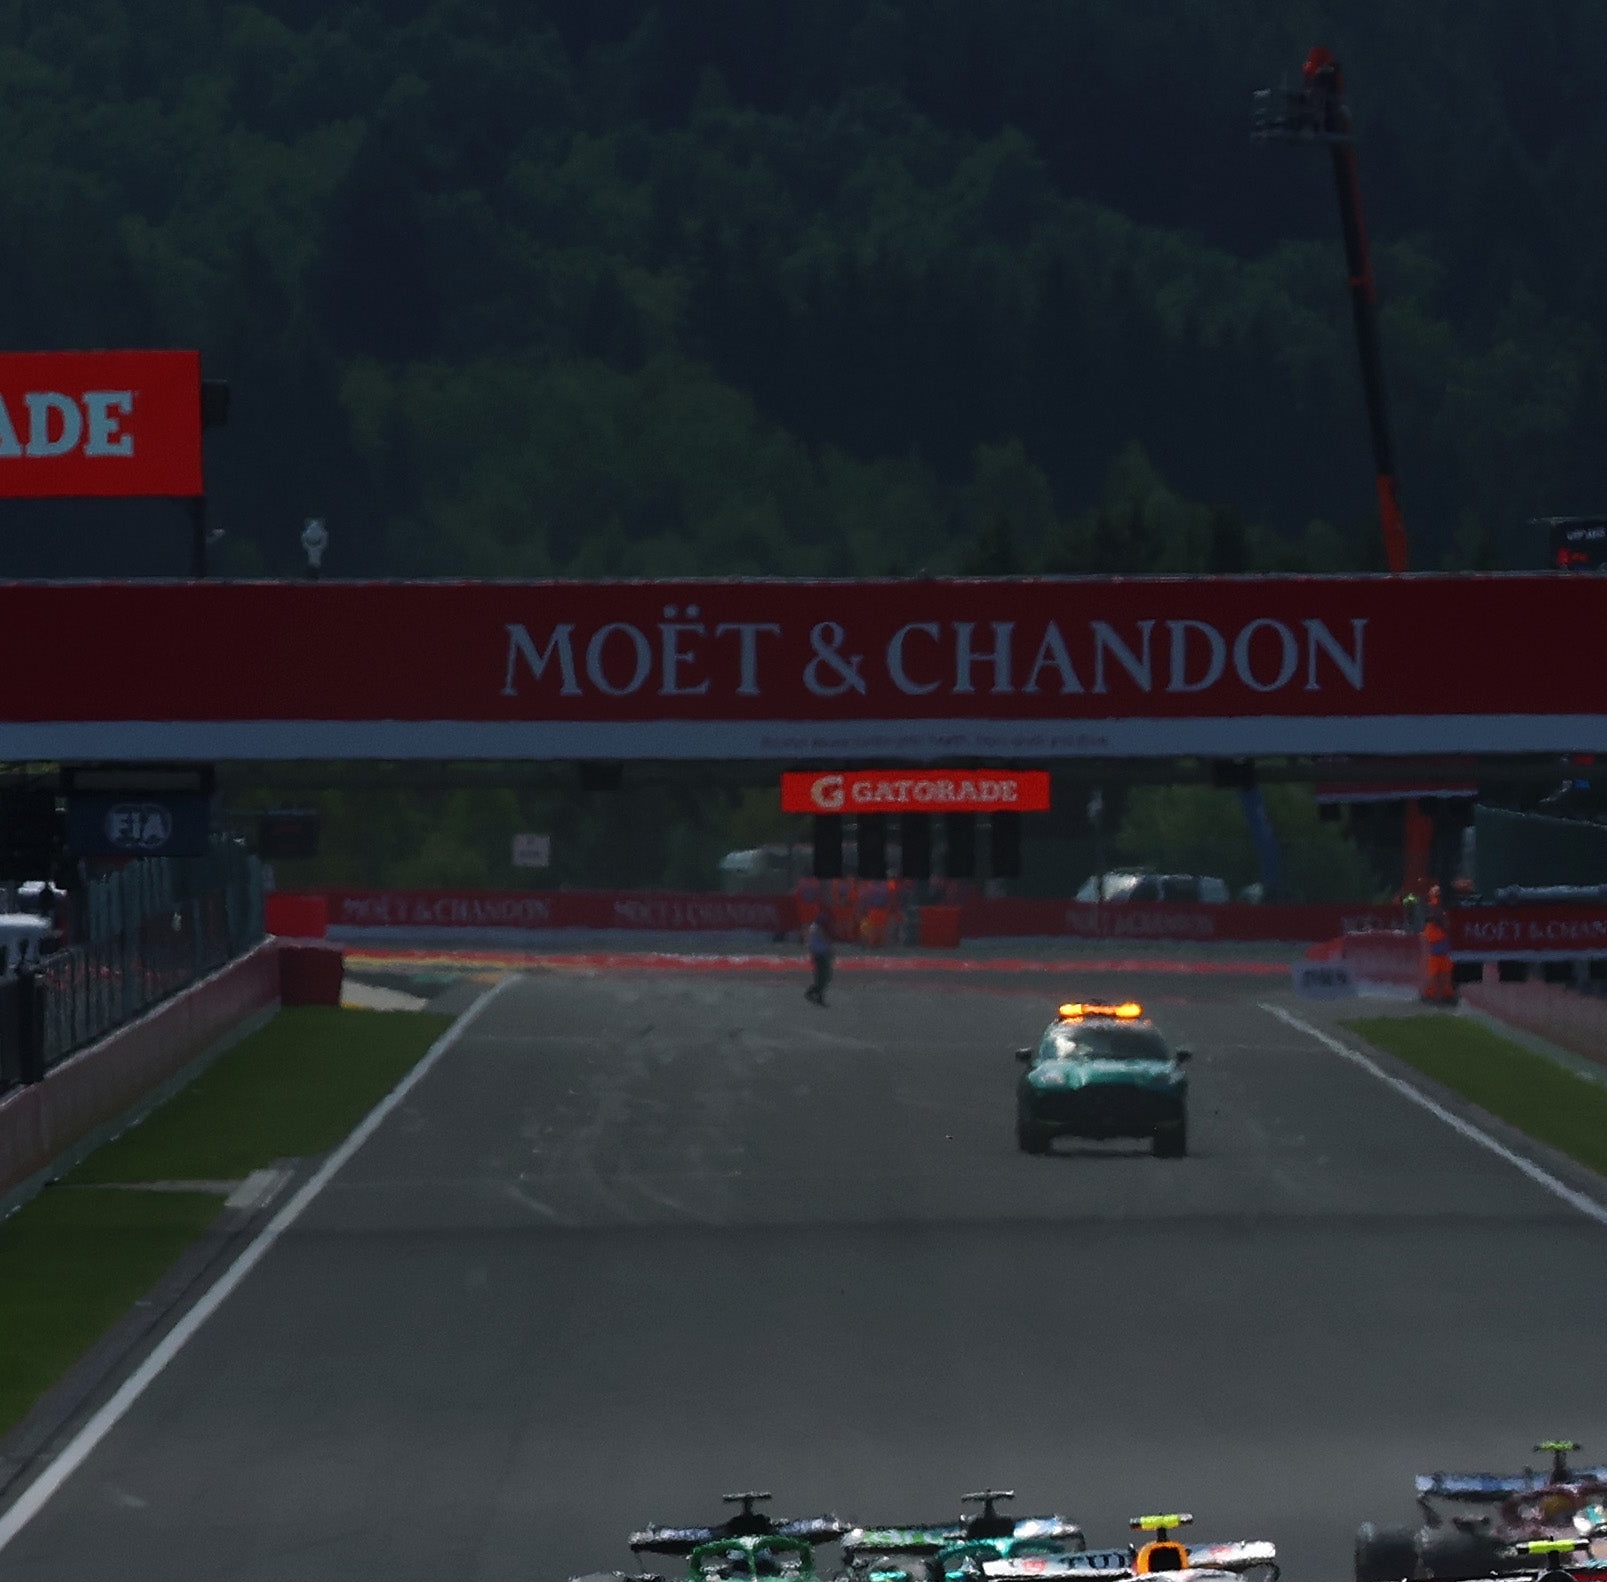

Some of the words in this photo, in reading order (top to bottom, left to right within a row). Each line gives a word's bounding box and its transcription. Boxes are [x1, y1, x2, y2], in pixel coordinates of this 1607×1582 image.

[501, 604, 782, 697] MOËT
[802, 620, 869, 696] &
[885, 617, 1372, 695] CHANDON
[851, 779, 1018, 803] GATORADE
[110, 812, 166, 840] FIA
